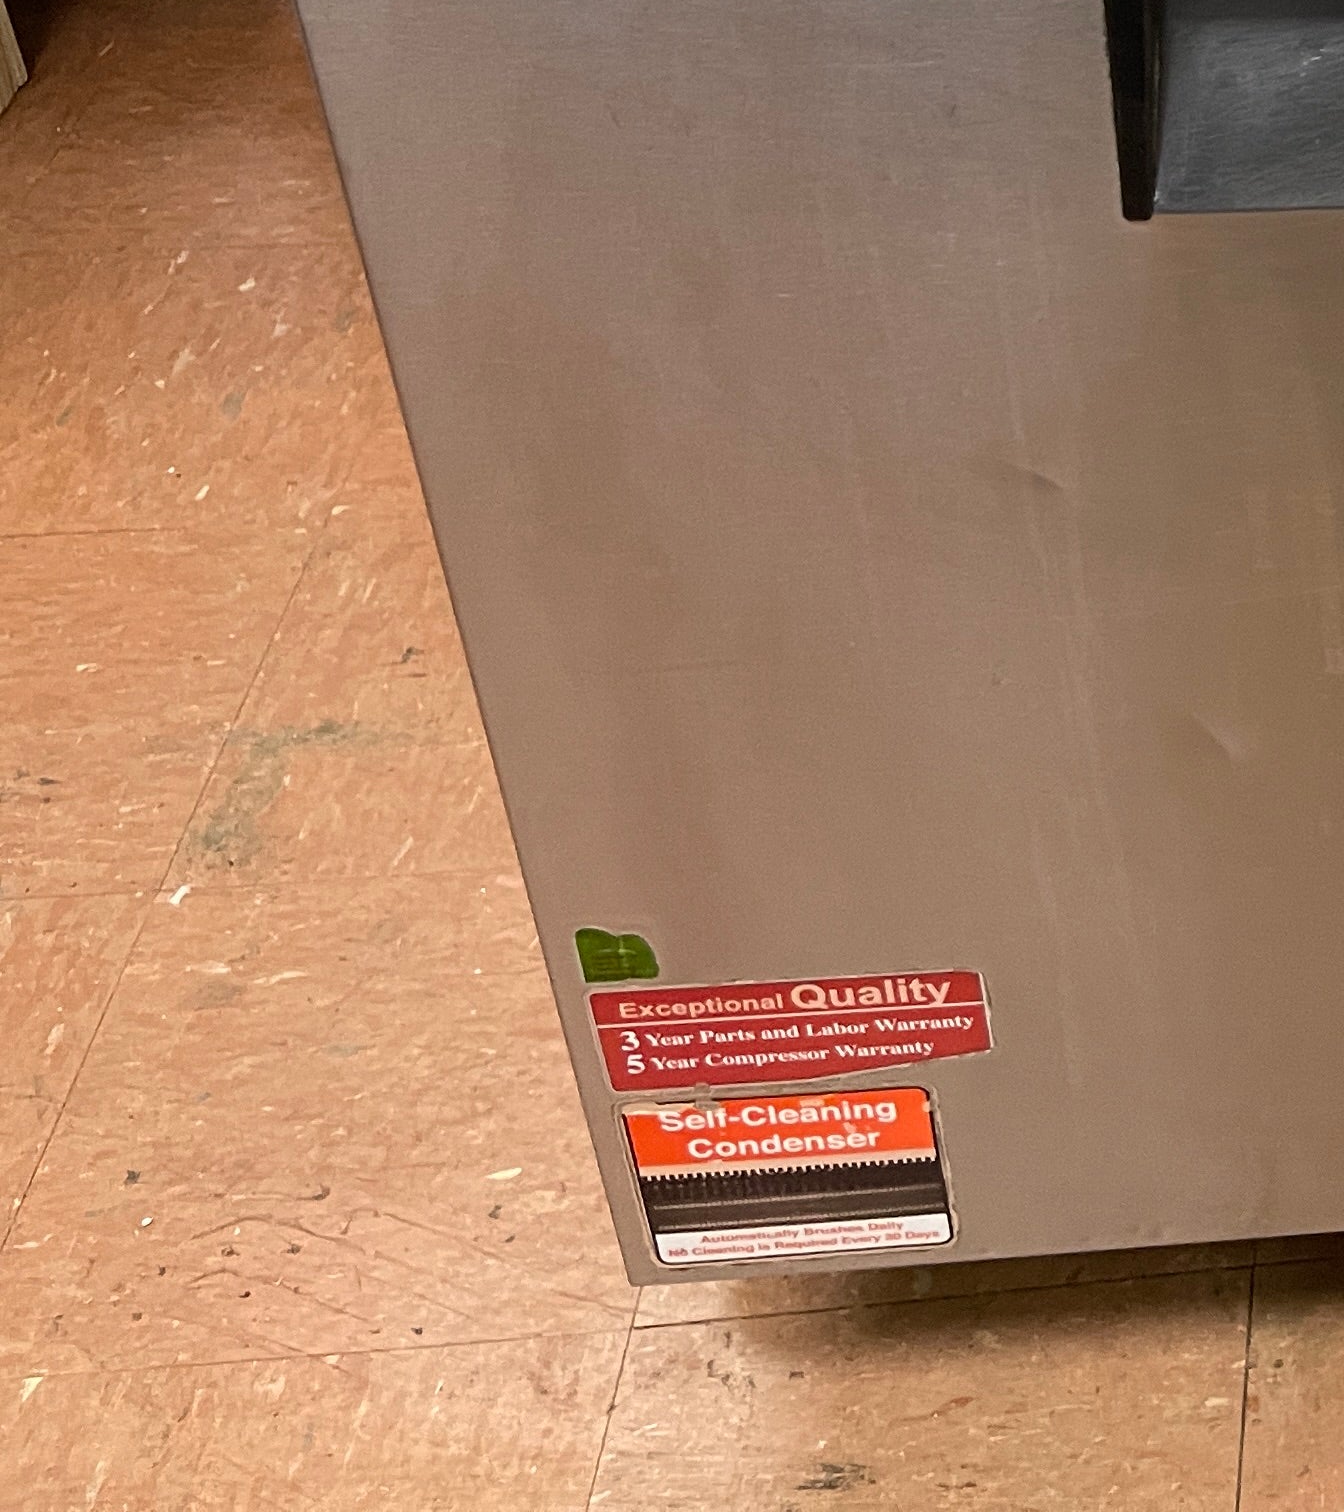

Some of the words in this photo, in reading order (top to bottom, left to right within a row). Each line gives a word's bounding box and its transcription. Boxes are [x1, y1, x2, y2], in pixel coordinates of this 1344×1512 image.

[619, 993, 783, 1020] Exceptional
[790, 977, 951, 1010] Quality
[620, 1031, 640, 1052] 3
[645, 1033, 694, 1048] Year
[700, 1029, 755, 1044] Parts
[761, 1024, 799, 1039] and
[806, 1020, 869, 1038] Labor
[874, 1014, 974, 1035] Warranty
[627, 1054, 645, 1075] 5
[650, 1056, 699, 1071] Year
[705, 1047, 830, 1068] Compressor
[834, 1041, 935, 1058] Warranty
[660, 1100, 897, 1132] Self-Cleaning
[687, 1130, 881, 1159] Condenser
